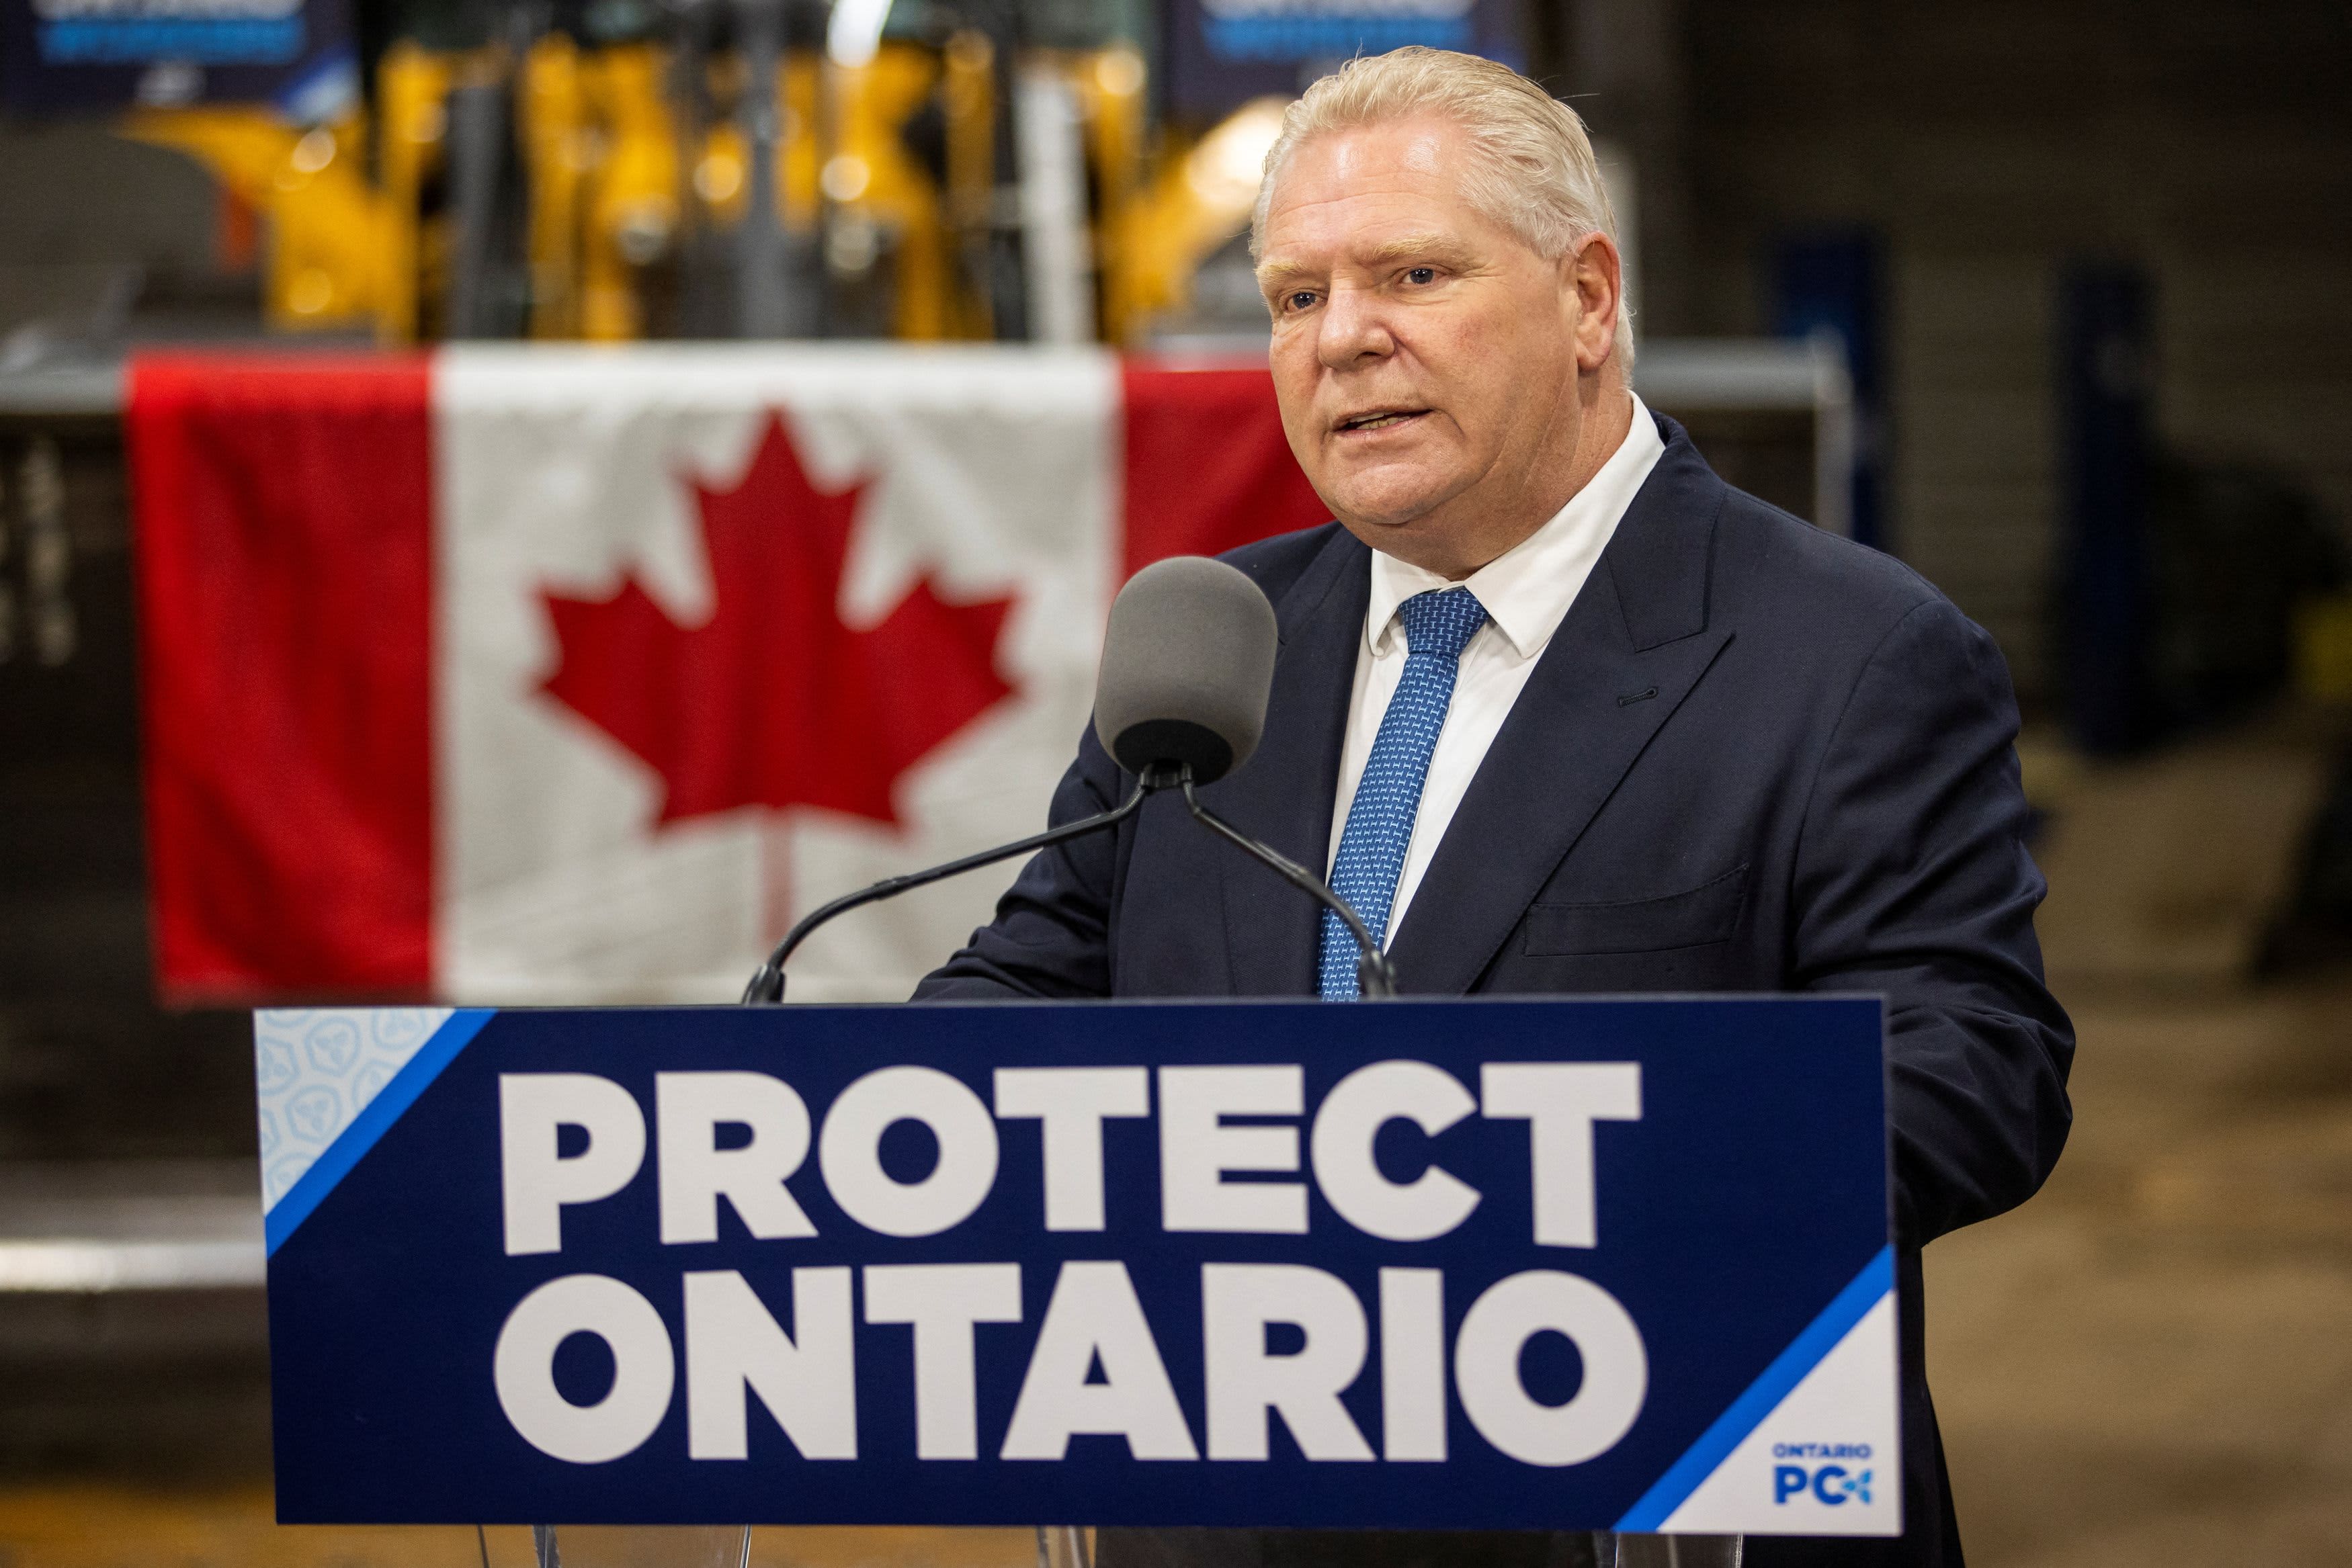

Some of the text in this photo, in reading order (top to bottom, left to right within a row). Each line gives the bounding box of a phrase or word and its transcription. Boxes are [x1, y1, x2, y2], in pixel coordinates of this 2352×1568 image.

[499, 1061, 1643, 1255] PROTECT
[493, 1261, 1648, 1466] ONTARIO
[1773, 1443, 1872, 1459] ONTARIO
[1773, 1465, 1847, 1506] PC
